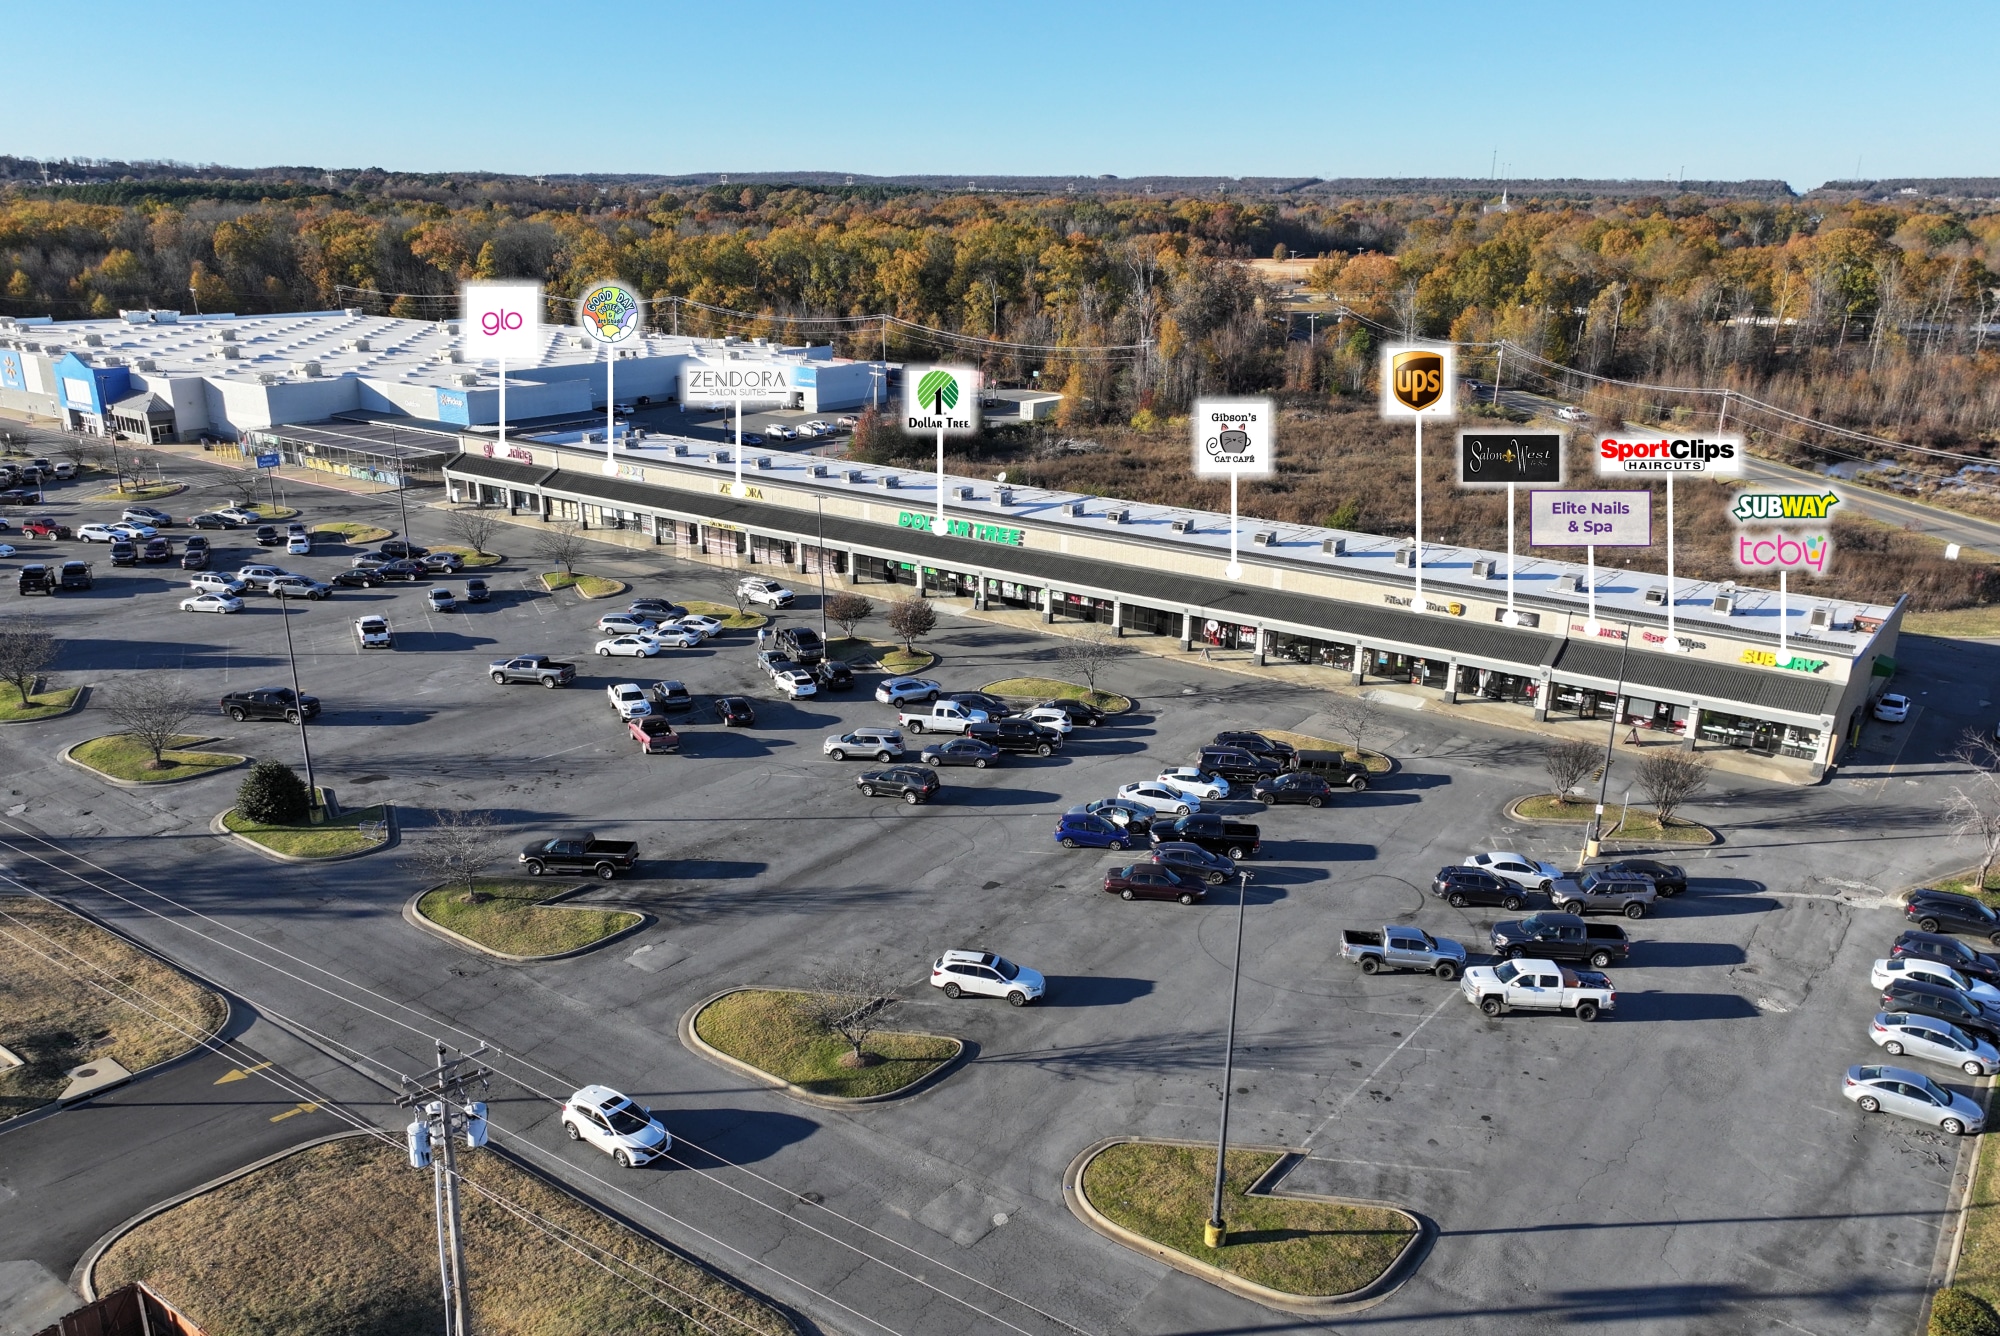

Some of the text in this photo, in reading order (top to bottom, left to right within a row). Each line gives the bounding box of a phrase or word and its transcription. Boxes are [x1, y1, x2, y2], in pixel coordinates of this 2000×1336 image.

[719, 483, 763, 500] ZEORA
[898, 511, 1021, 546] DOLAR TREE
